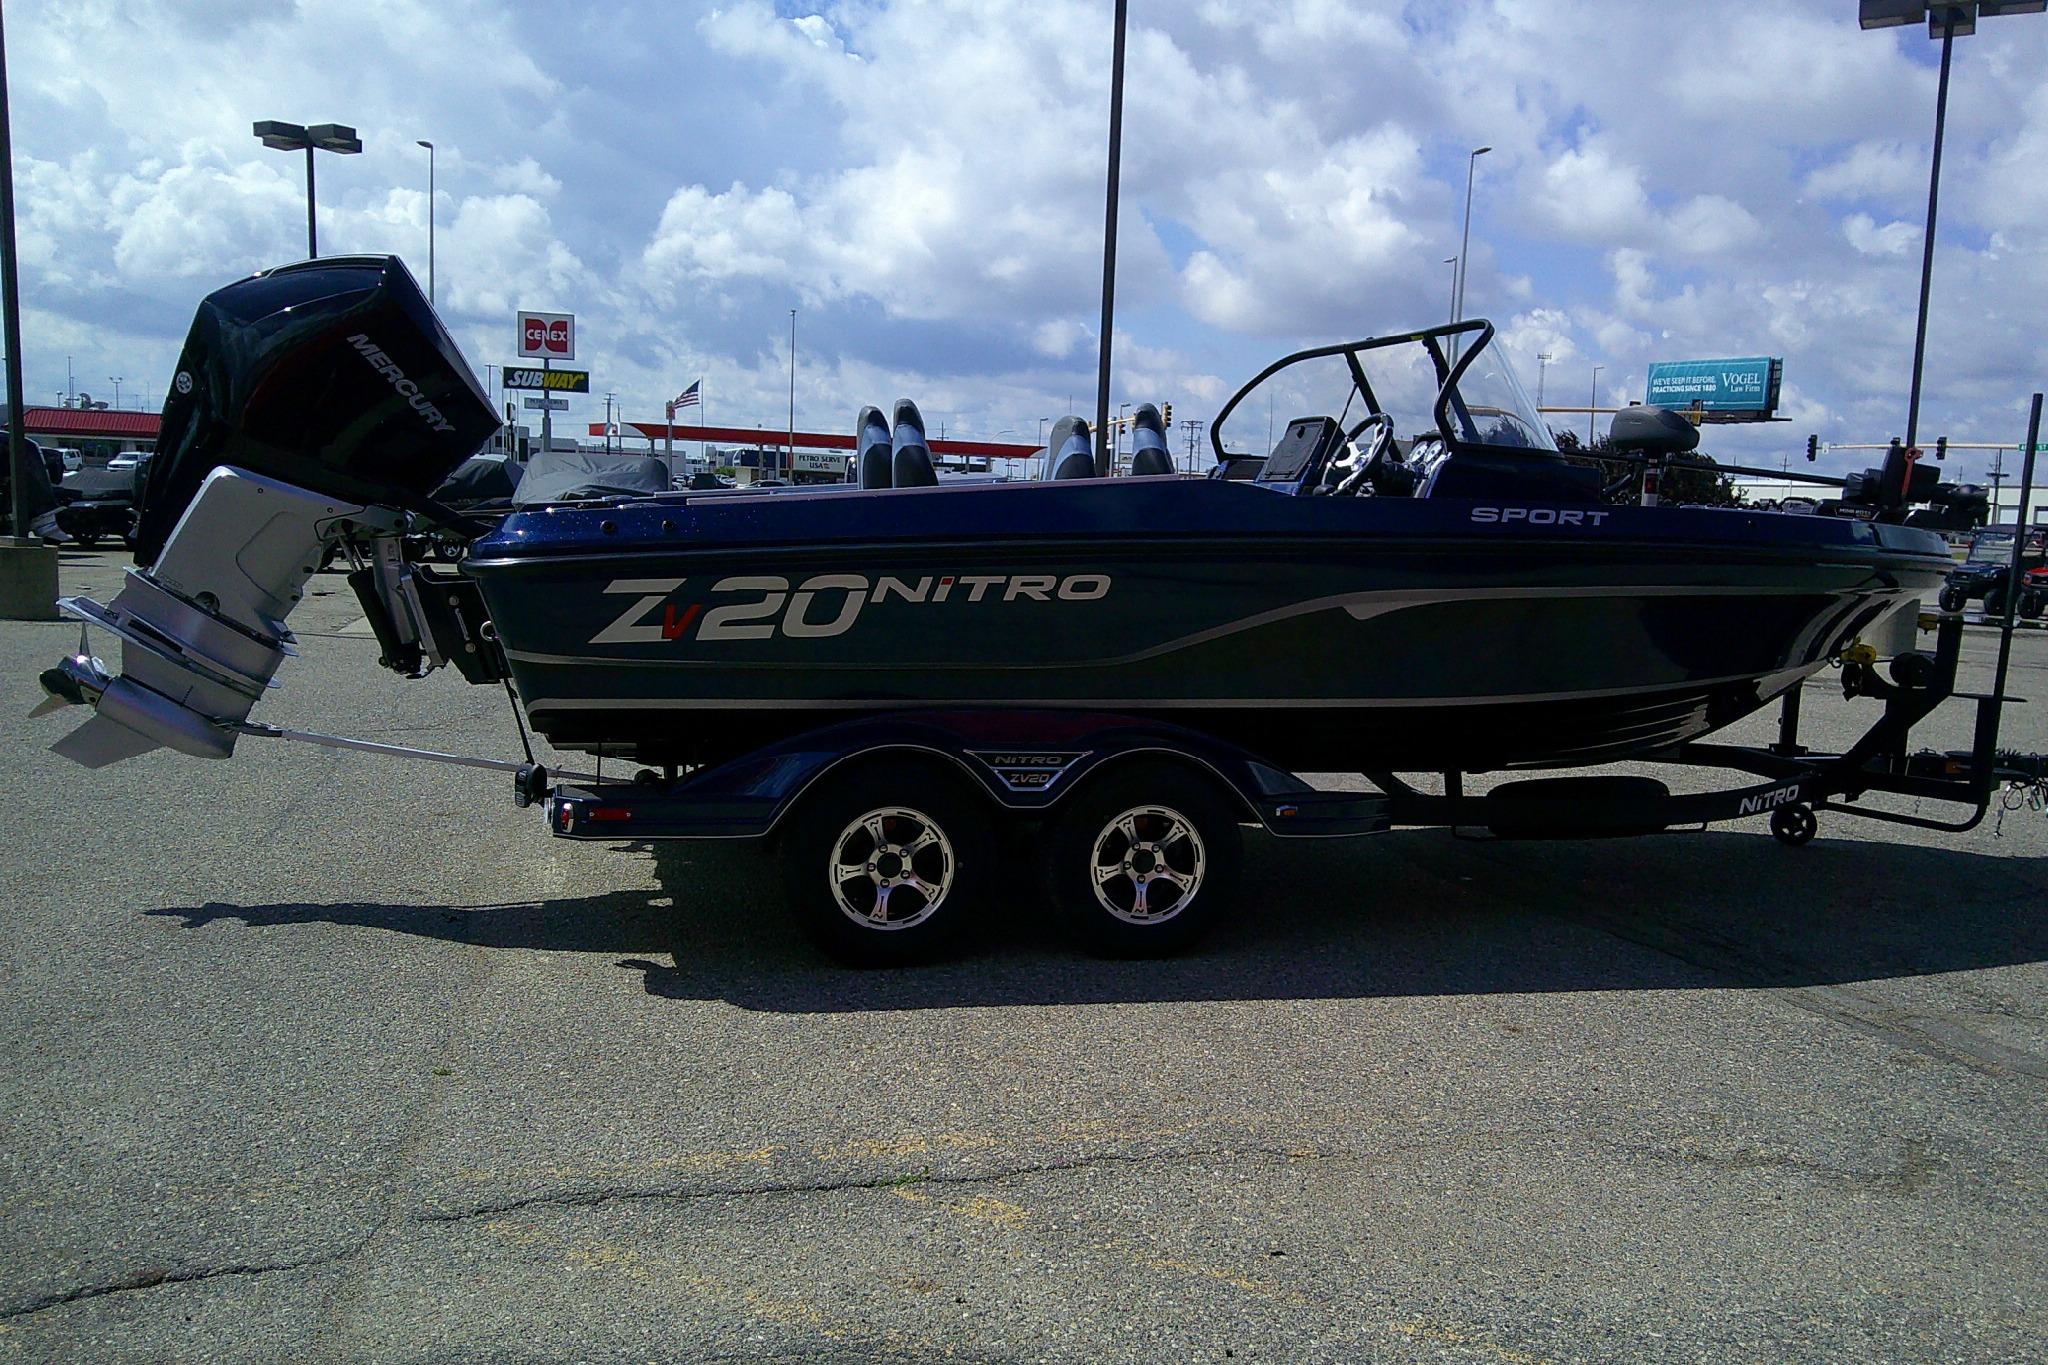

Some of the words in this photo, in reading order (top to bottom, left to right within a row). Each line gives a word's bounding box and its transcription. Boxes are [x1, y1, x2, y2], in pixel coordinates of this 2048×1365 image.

[526, 329, 567, 341] CENEX
[346, 333, 456, 432] MERCURY
[507, 370, 585, 389] SUBWAY
[1652, 377, 1671, 386] WE'VE
[1671, 376, 1686, 385] SEEN
[1685, 376, 1692, 384] IT
[1722, 372, 1761, 387] VOGEL
[1652, 385, 1685, 393] PRACTICING
[1685, 385, 1702, 393] SINCE
[1730, 385, 1744, 393] Law
[1744, 384, 1761, 393] Firm
[1470, 507, 1610, 526] SPORT
[994, 755, 1063, 765] NITRO
[1009, 773, 1051, 783] ZV20
